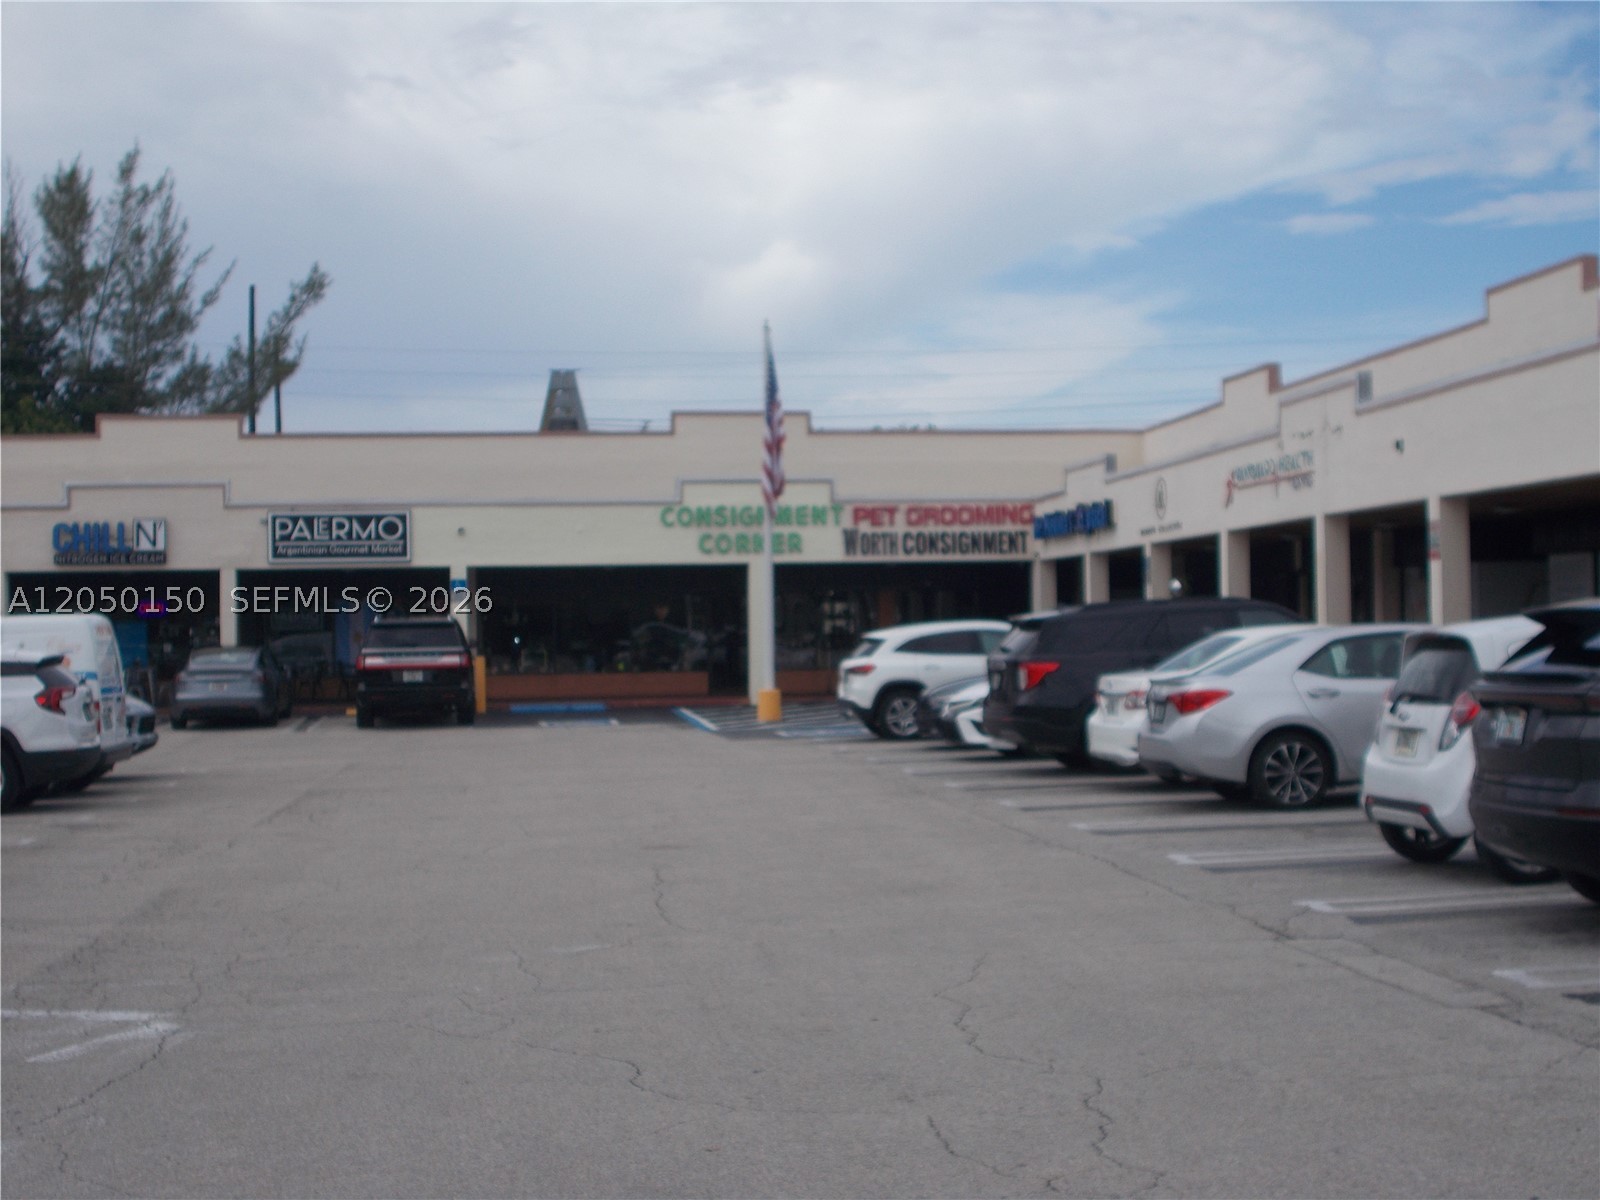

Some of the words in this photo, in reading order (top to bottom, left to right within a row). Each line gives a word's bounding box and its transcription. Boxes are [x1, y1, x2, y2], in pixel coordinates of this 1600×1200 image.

[853, 505, 897, 526] PET
[906, 503, 1034, 527] GROOMING
[53, 521, 132, 554] CHILL
[275, 516, 402, 540] PALERMO
[698, 532, 803, 555] CORNER
[843, 528, 898, 557] WORTH
[903, 530, 1028, 555] CONSIGNMENT
